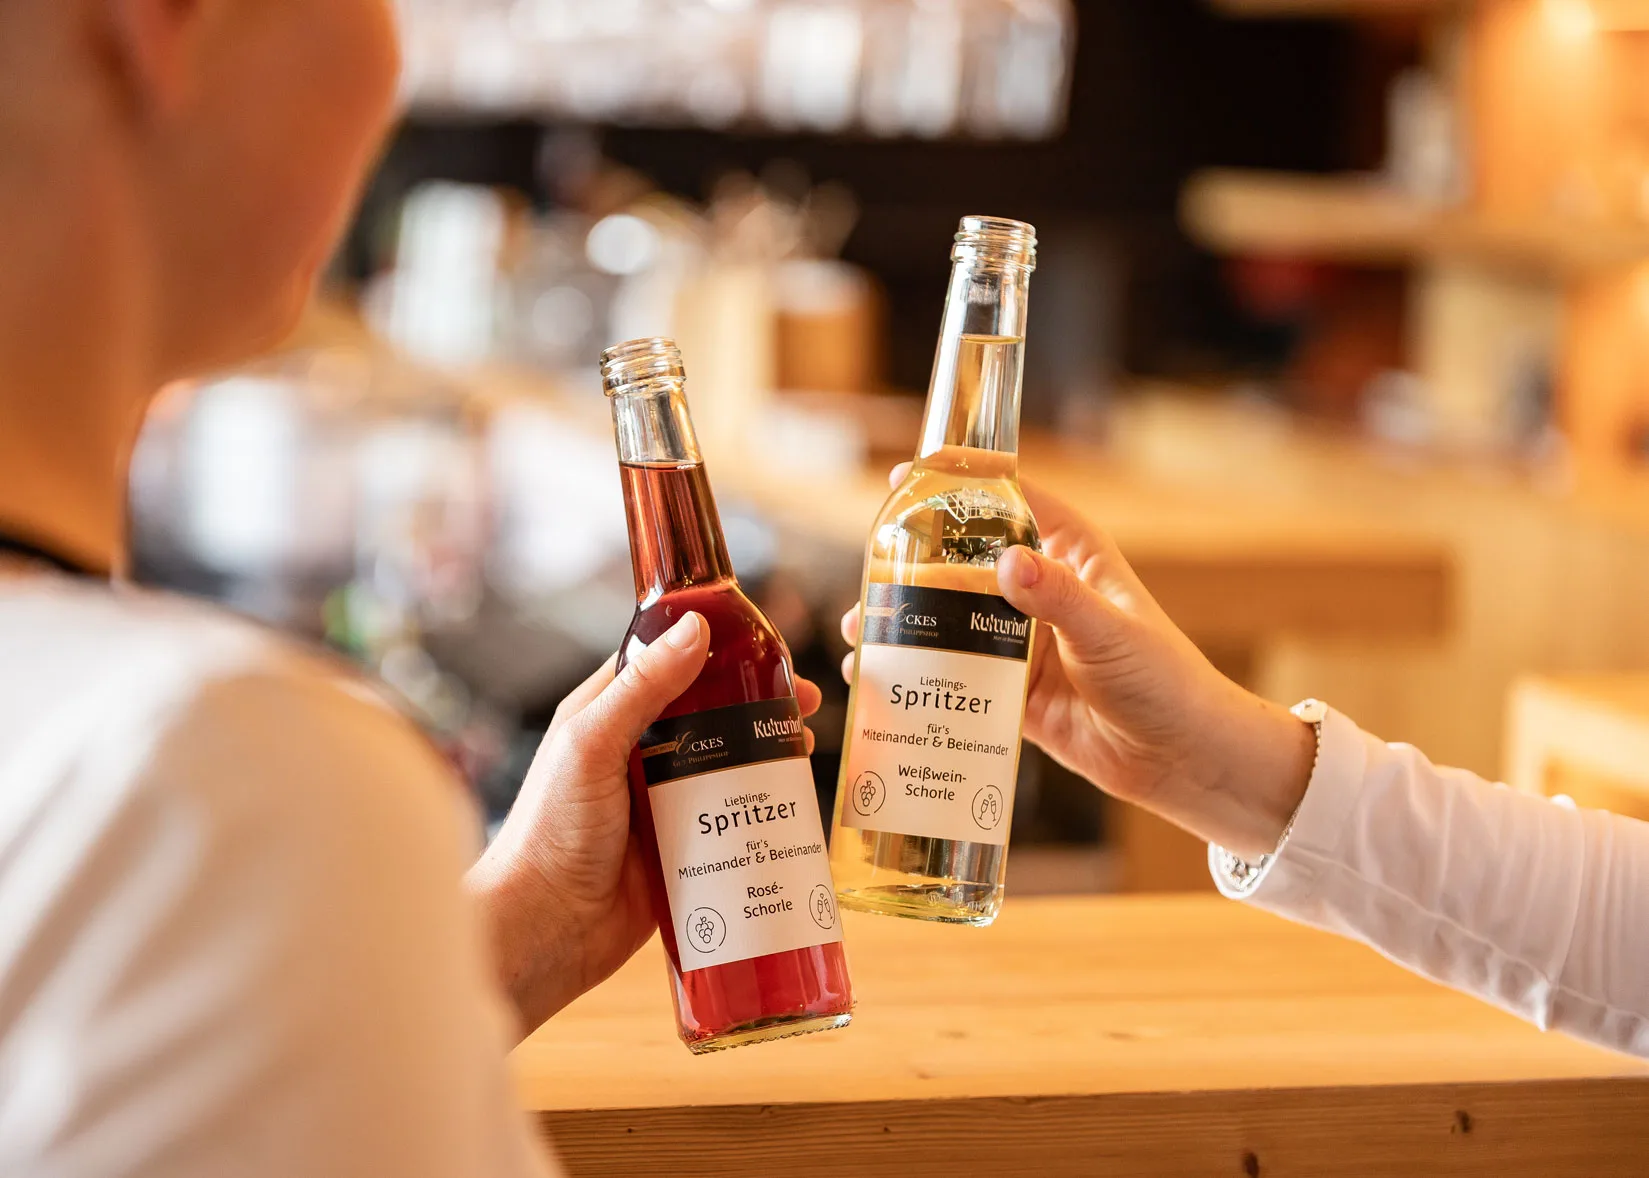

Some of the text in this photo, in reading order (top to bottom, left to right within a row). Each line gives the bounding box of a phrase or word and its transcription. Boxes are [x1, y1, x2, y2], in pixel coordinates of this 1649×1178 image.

[970, 611, 1029, 638] Kulturhof
[920, 676, 968, 690] Lieblings-
[890, 684, 992, 715] Spritzer
[926, 723, 950, 735] für's
[674, 730, 725, 756] ECKES
[862, 729, 1009, 756] Miteinander & Beieinander
[898, 764, 967, 783] Weißwein-
[724, 792, 771, 807] Lieblings-
[905, 783, 956, 801] Schorle
[698, 800, 796, 836] Spritzer
[746, 839, 769, 853] für's
[678, 843, 823, 880] Miteinander & Beieinander
[747, 881, 784, 899] Rosé-
[743, 899, 794, 919] Schorle
